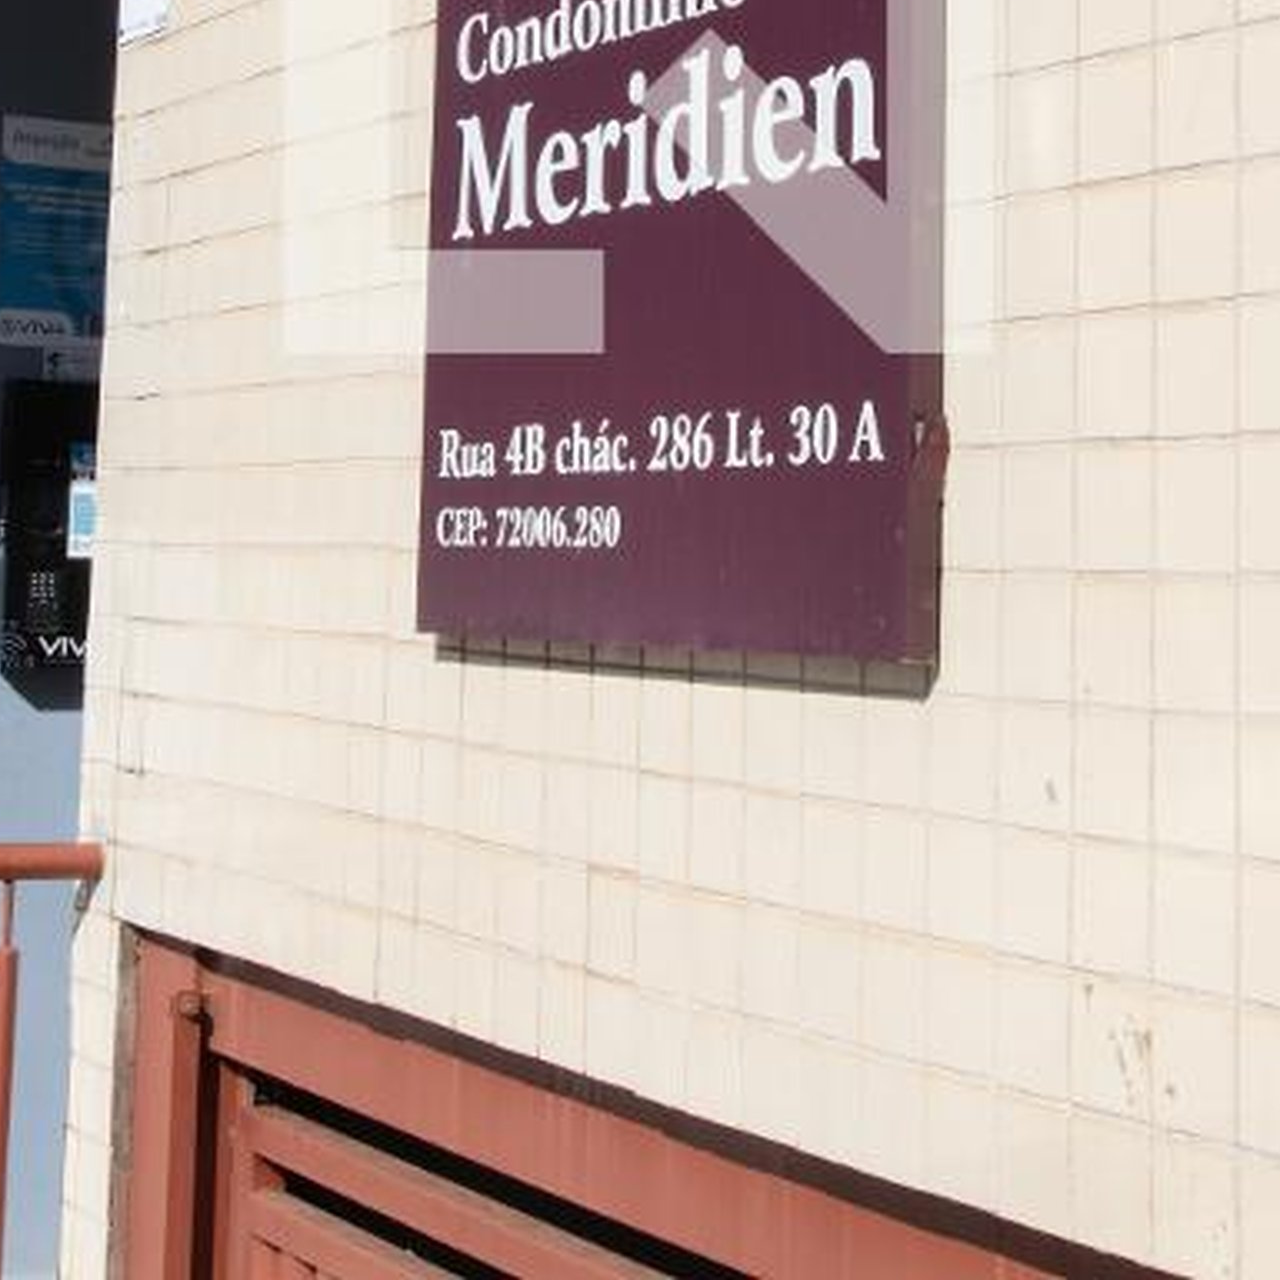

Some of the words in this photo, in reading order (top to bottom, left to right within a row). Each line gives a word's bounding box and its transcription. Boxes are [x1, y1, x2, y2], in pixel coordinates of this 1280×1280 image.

[452, 44, 881, 240] Meridien
[439, 429, 496, 479] Rua
[504, 423, 546, 476] 4B
[555, 419, 637, 475] chác.
[647, 413, 714, 472] 286
[724, 411, 775, 469] Lt.
[788, 403, 839, 465] 30
[848, 400, 885, 462] A
[436, 506, 488, 548] CEP:
[495, 506, 622, 549] 72006.280
